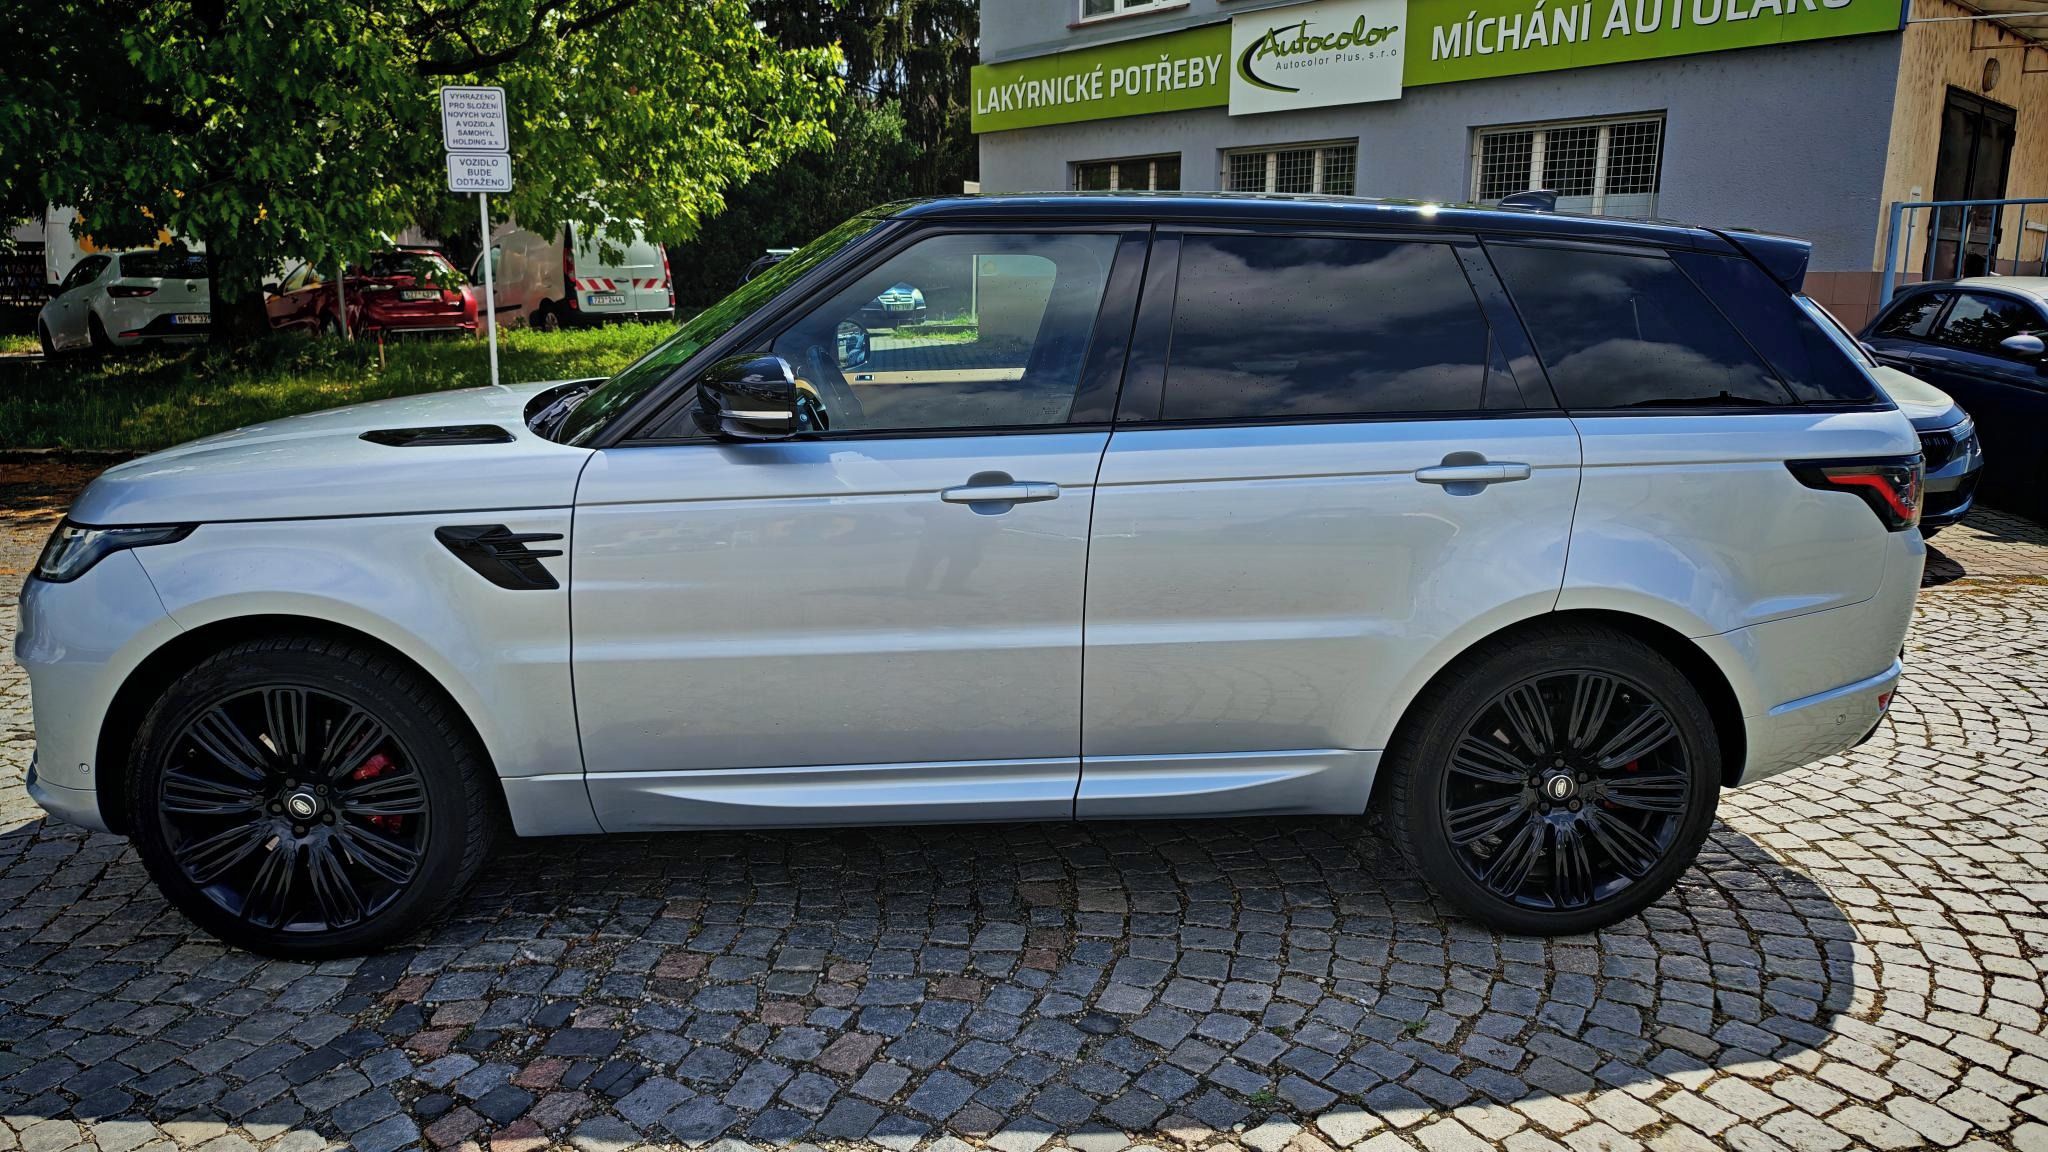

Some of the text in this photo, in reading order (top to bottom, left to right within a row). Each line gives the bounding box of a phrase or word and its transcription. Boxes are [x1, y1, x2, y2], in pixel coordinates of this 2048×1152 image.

[1431, 0, 1592, 61] MÍCHÁNÍ
[1256, 14, 1398, 61] Autocolor
[1275, 56, 1329, 71] Autocolor
[977, 54, 1223, 115] LAKÝRNICKÉ POTŘEBY
[450, 93, 496, 101] VYHRAZENO
[466, 101, 499, 110] SLOŽENÍ
[459, 158, 498, 167] VOZIDLO
[467, 168, 492, 177] BUDE
[456, 176, 505, 186] ODTAŽENO
